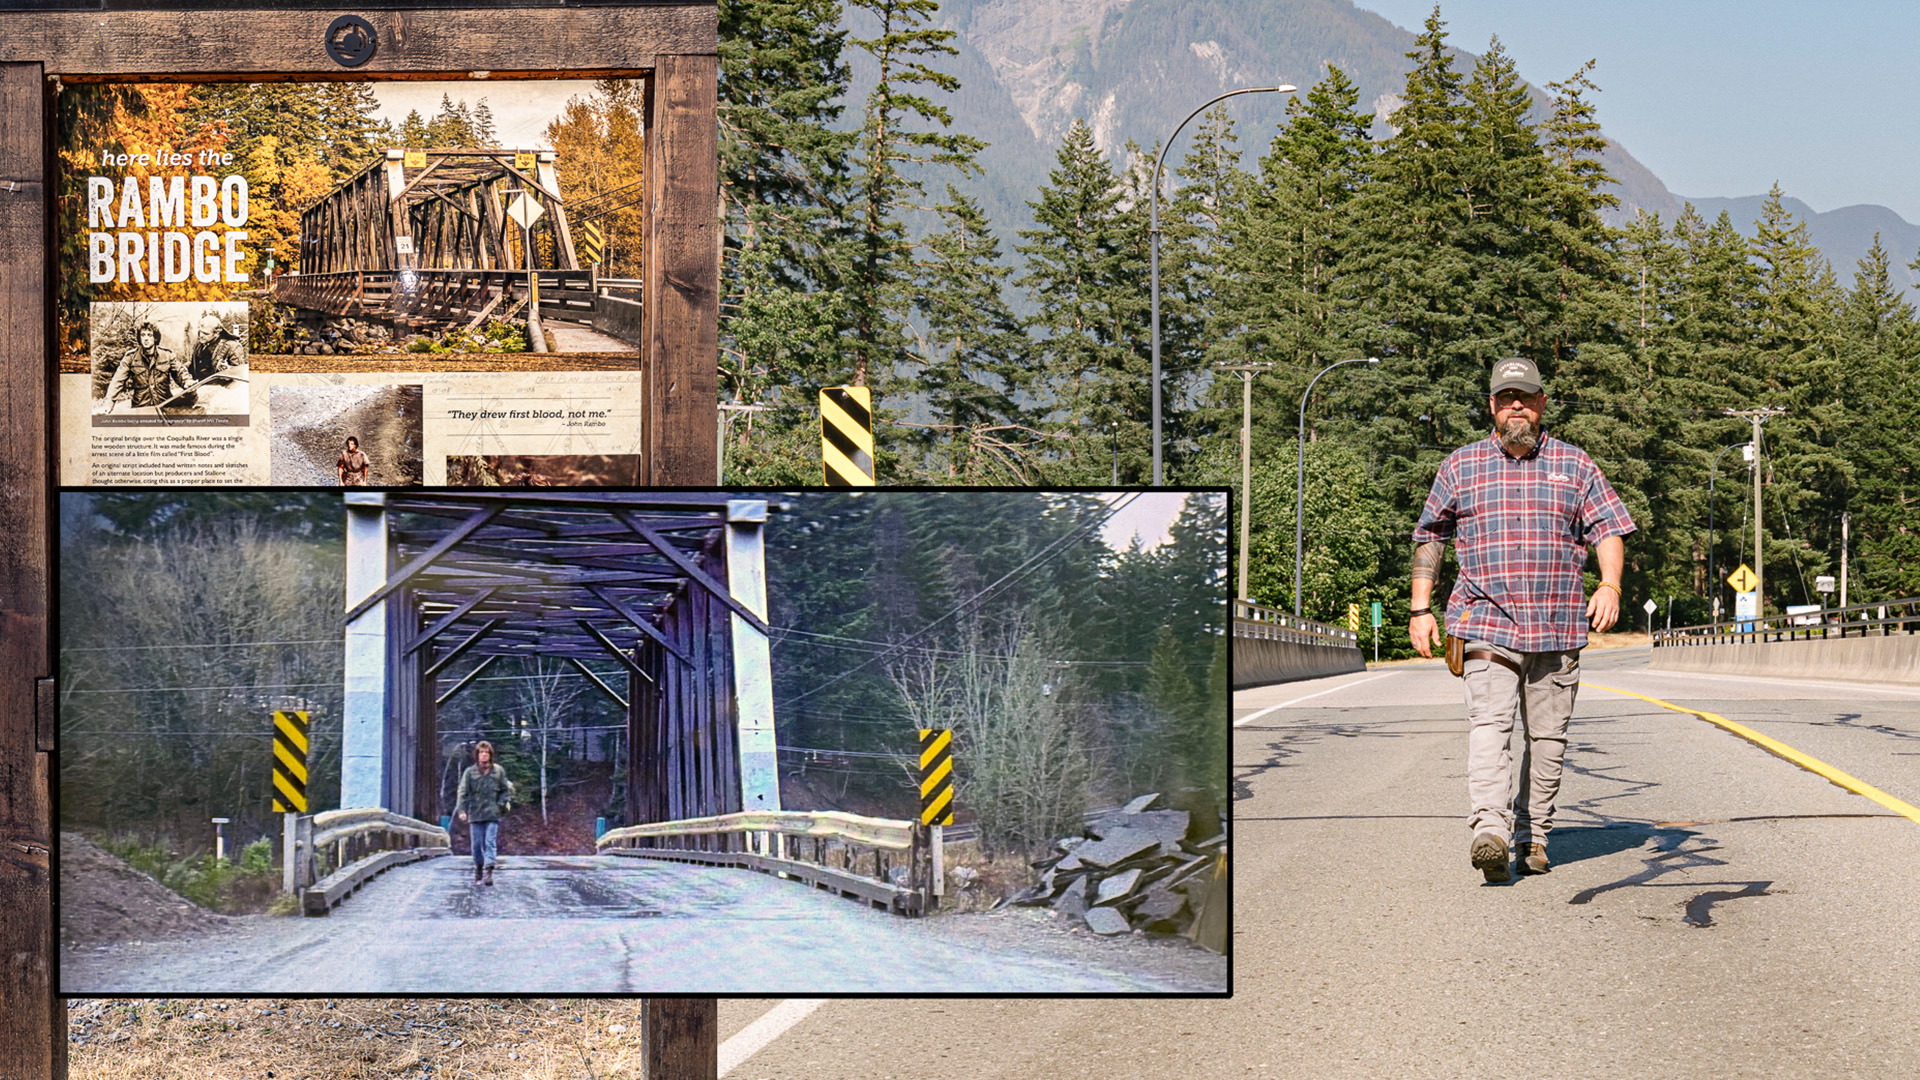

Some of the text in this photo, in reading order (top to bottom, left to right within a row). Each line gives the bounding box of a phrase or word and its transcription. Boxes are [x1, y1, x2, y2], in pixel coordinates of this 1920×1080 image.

[102, 150, 234, 166] here lies the
[88, 175, 249, 228] RAMBO
[89, 230, 249, 283] BRIDGE
[480, 410, 506, 418] drew
[510, 410, 530, 418] first
[532, 410, 564, 420] blood,
[568, 410, 586, 418] not
